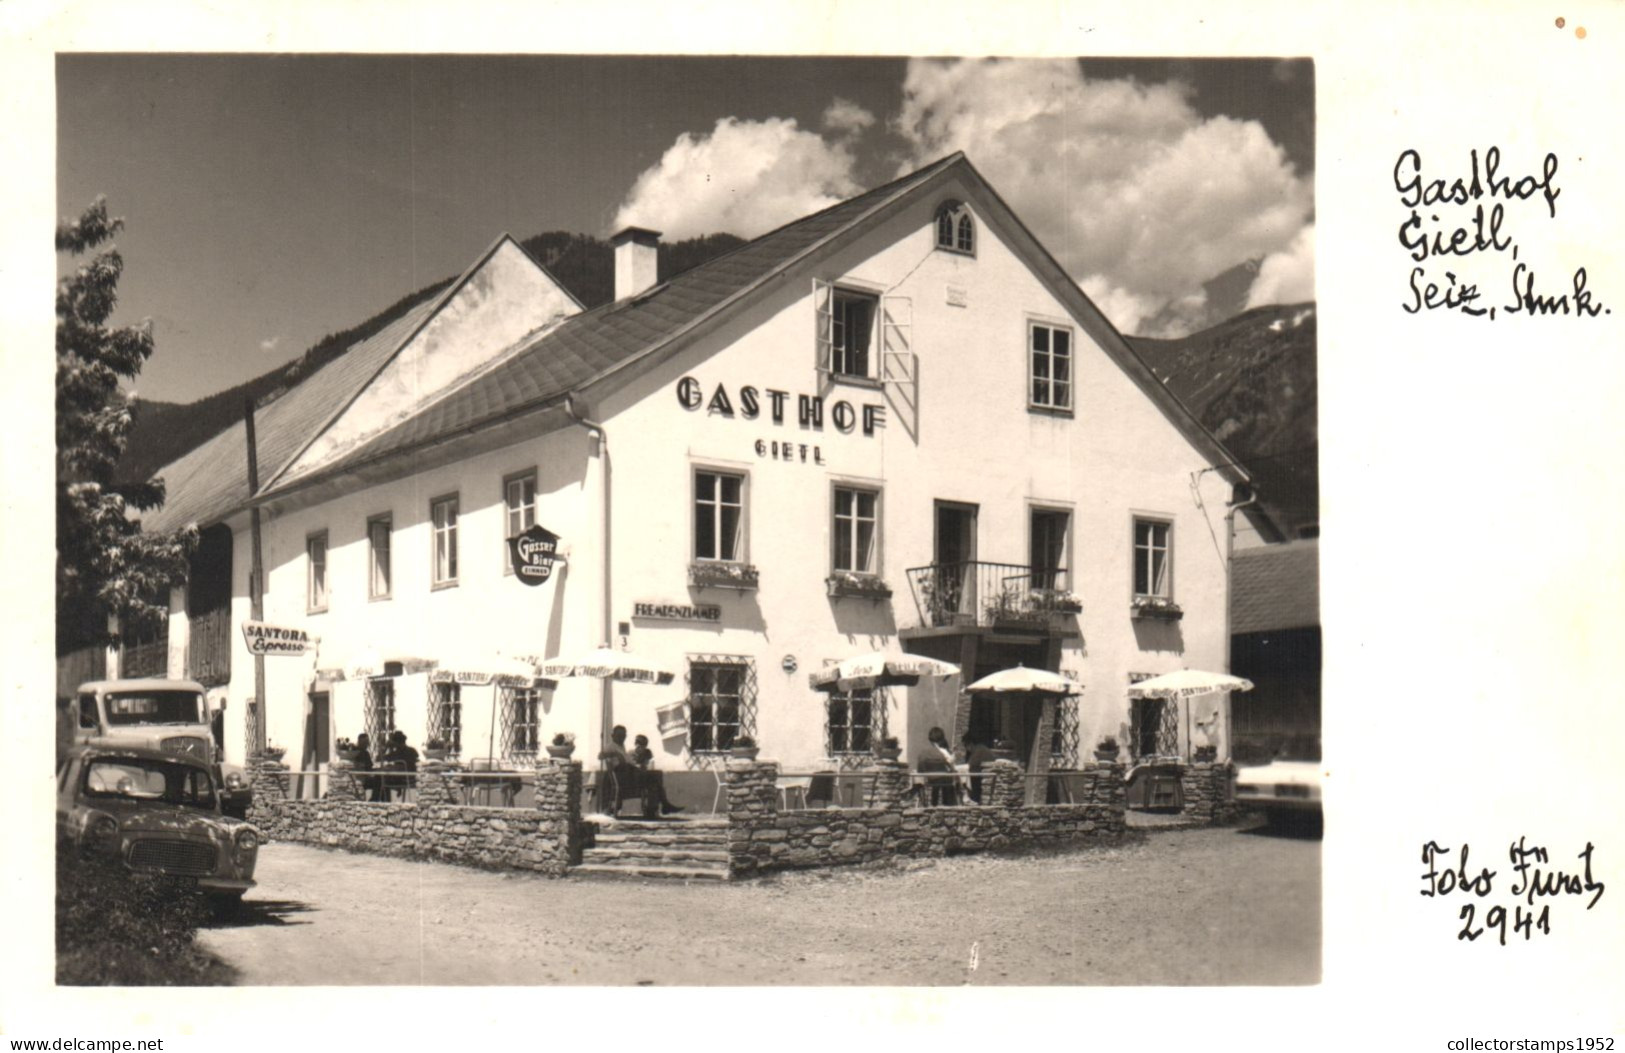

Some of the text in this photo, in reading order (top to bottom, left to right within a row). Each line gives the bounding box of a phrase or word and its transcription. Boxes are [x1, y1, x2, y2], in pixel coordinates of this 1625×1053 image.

[1394, 146, 1561, 219] Gasthof
[676, 375, 887, 437] GASTHOF
[755, 439, 827, 465] GIETL
[517, 535, 555, 564] Gösser
[533, 553, 553, 566] Bier
[635, 603, 721, 620] FREMDENZIMMER
[247, 625, 308, 642] SANTORA
[252, 637, 305, 653] Espresso
[1420, 840, 1497, 898] Foto
[1458, 903, 1550, 946] 2941
